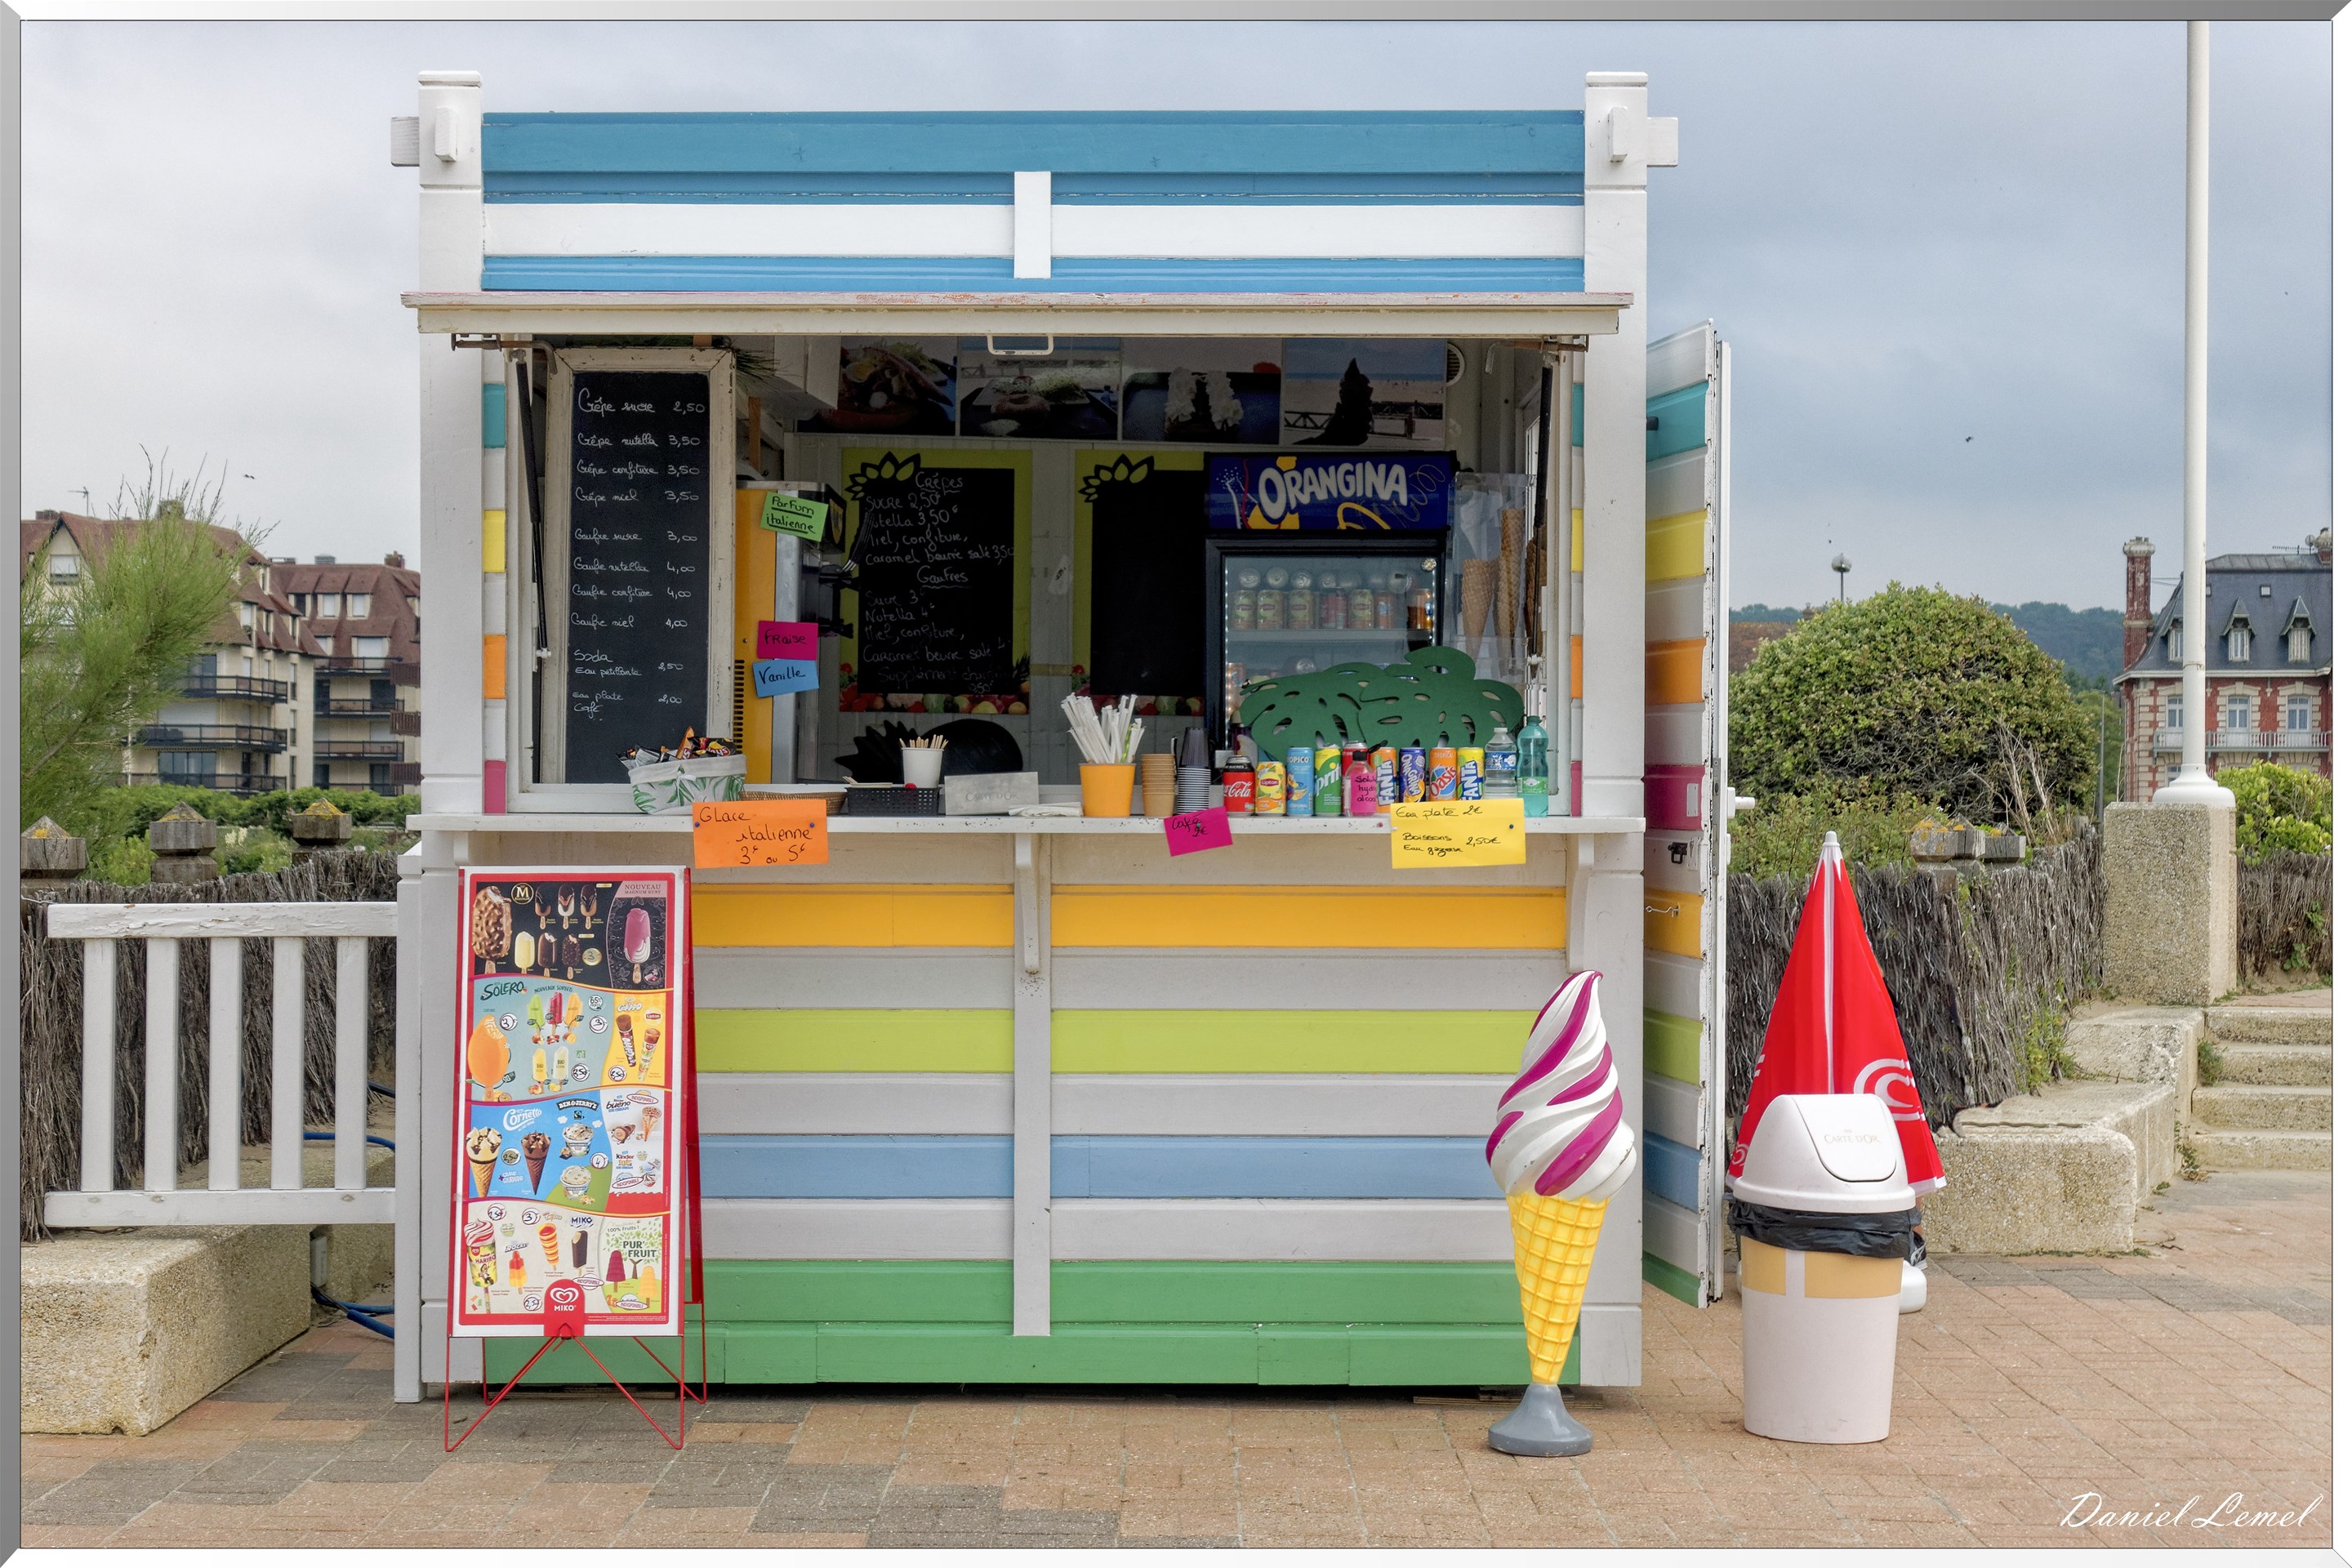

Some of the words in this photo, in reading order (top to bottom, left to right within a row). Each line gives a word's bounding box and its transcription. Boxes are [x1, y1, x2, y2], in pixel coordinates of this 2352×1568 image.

[578, 387, 616, 417] Crêpe
[621, 401, 656, 412] sucre
[672, 401, 706, 415] 2,50
[577, 432, 612, 448] Crêpe
[621, 433, 658, 447] nutella
[668, 434, 701, 448] 3,50
[577, 459, 607, 477] Crêpe
[612, 461, 659, 479] confiture
[667, 465, 700, 477] 3,50
[575, 487, 607, 507] Crêpe
[612, 488, 639, 501] miel
[665, 490, 700, 503] 3,50
[1258, 461, 1408, 519] ORANGINA
[766, 514, 816, 533] italienne
[872, 513, 914, 528] utella
[575, 528, 609, 545] Gaufre
[612, 532, 643, 541] sucre
[667, 531, 697, 543] 3,00
[573, 556, 607, 574] Gaufre
[608, 562, 649, 572] nutella
[666, 561, 695, 574] 4,00
[572, 583, 608, 600] Gaufre
[612, 585, 653, 603] confiture
[667, 587, 692, 599] 4,00
[571, 612, 608, 630] Gaufre
[612, 615, 635, 627] miel
[666, 618, 688, 629] 4,00
[865, 608, 915, 622] Nutella
[573, 649, 613, 662] Soda
[575, 666, 596, 675] Eau
[658, 662, 684, 671] 2,50
[759, 666, 805, 684] Vanille
[595, 690, 624, 702] plate
[658, 694, 682, 704] 2,00
[1316, 763, 1342, 796] prit
[1376, 760, 1395, 806] FANTA
[1430, 765, 1456, 796] Oasis
[1396, 806, 1419, 817] Eau
[1423, 807, 1459, 820] plate
[1463, 805, 1483, 815] 2€
[735, 823, 813, 842] italienne
[1402, 832, 1452, 841] Boissons
[1466, 836, 1501, 847] 2,50€
[741, 845, 759, 864] 3€
[480, 981, 524, 1001] SOLERO
[606, 1101, 630, 1110] bueno
[503, 1108, 541, 1131] Cornetto
[1824, 1134, 1853, 1143] CARTE
[1855, 1134, 1880, 1143] D'OR
[623, 1241, 644, 1249] PUR'
[628, 1250, 657, 1258] FRUIT
[475, 1254, 497, 1263] HARIBO
